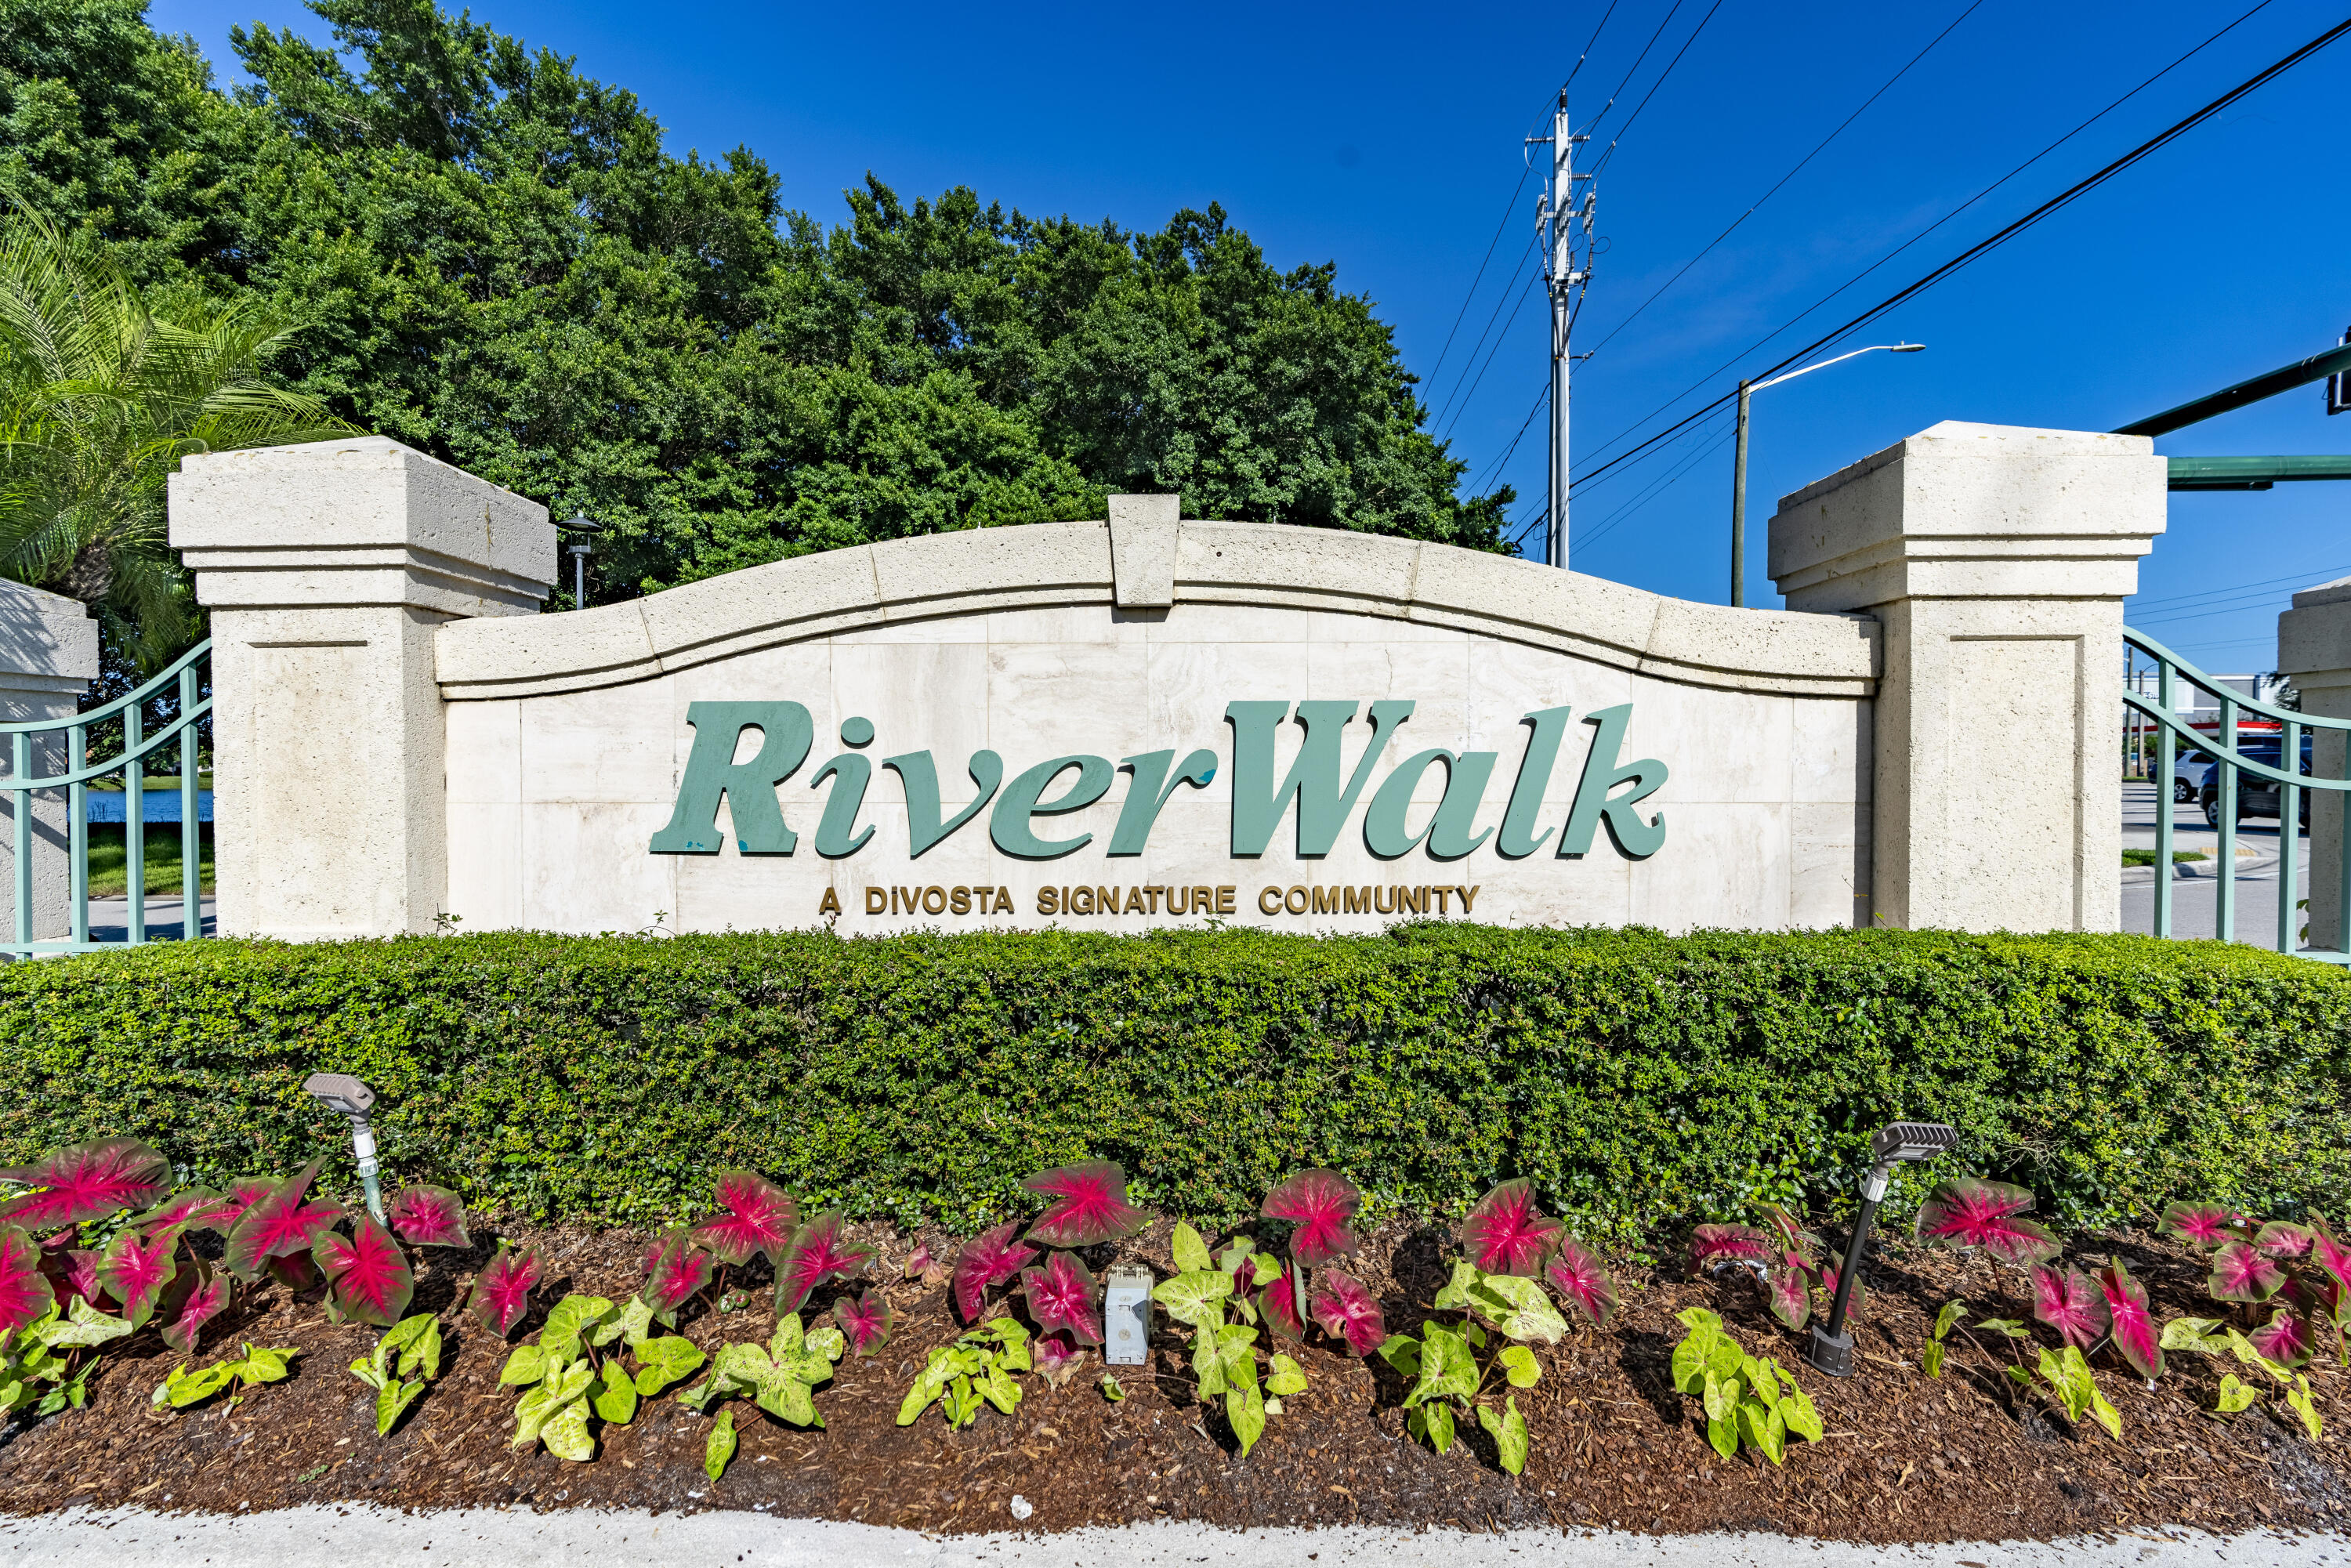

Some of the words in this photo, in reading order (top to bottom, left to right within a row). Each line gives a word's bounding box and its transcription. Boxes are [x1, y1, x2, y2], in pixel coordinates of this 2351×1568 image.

[649, 700, 1669, 859] RiverWalk
[819, 886, 842, 915] A
[1037, 885, 1237, 915] SIGNATURE
[1259, 885, 1480, 915] COMMUNITY
